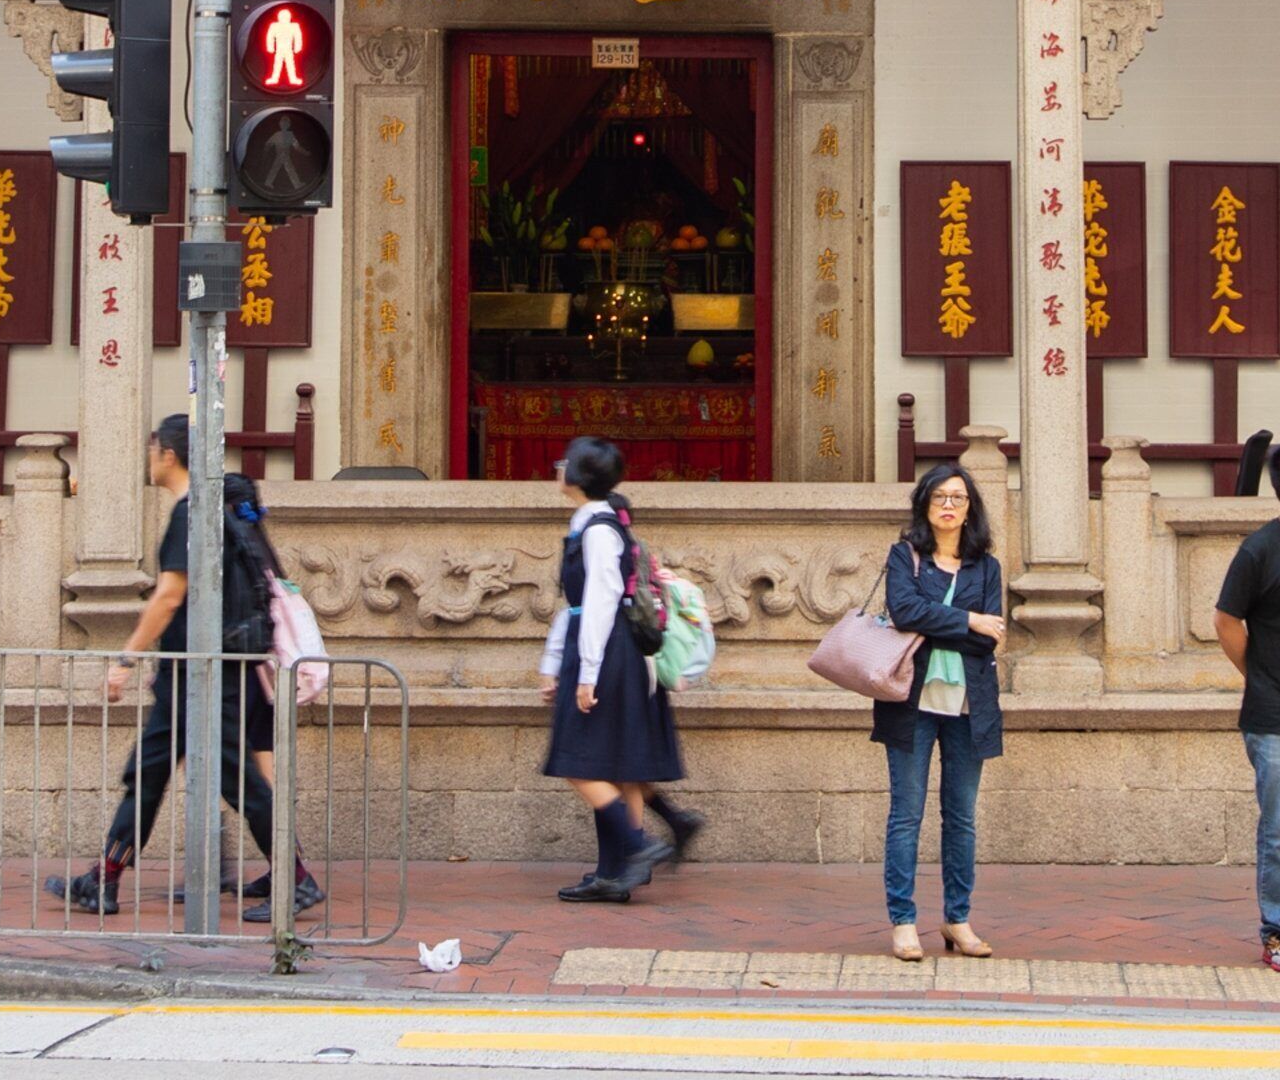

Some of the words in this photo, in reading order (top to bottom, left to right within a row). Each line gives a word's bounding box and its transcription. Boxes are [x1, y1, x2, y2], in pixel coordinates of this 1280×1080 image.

[597, 54, 634, 64] 129-131
[1208, 185, 1246, 336] 金花夫人
